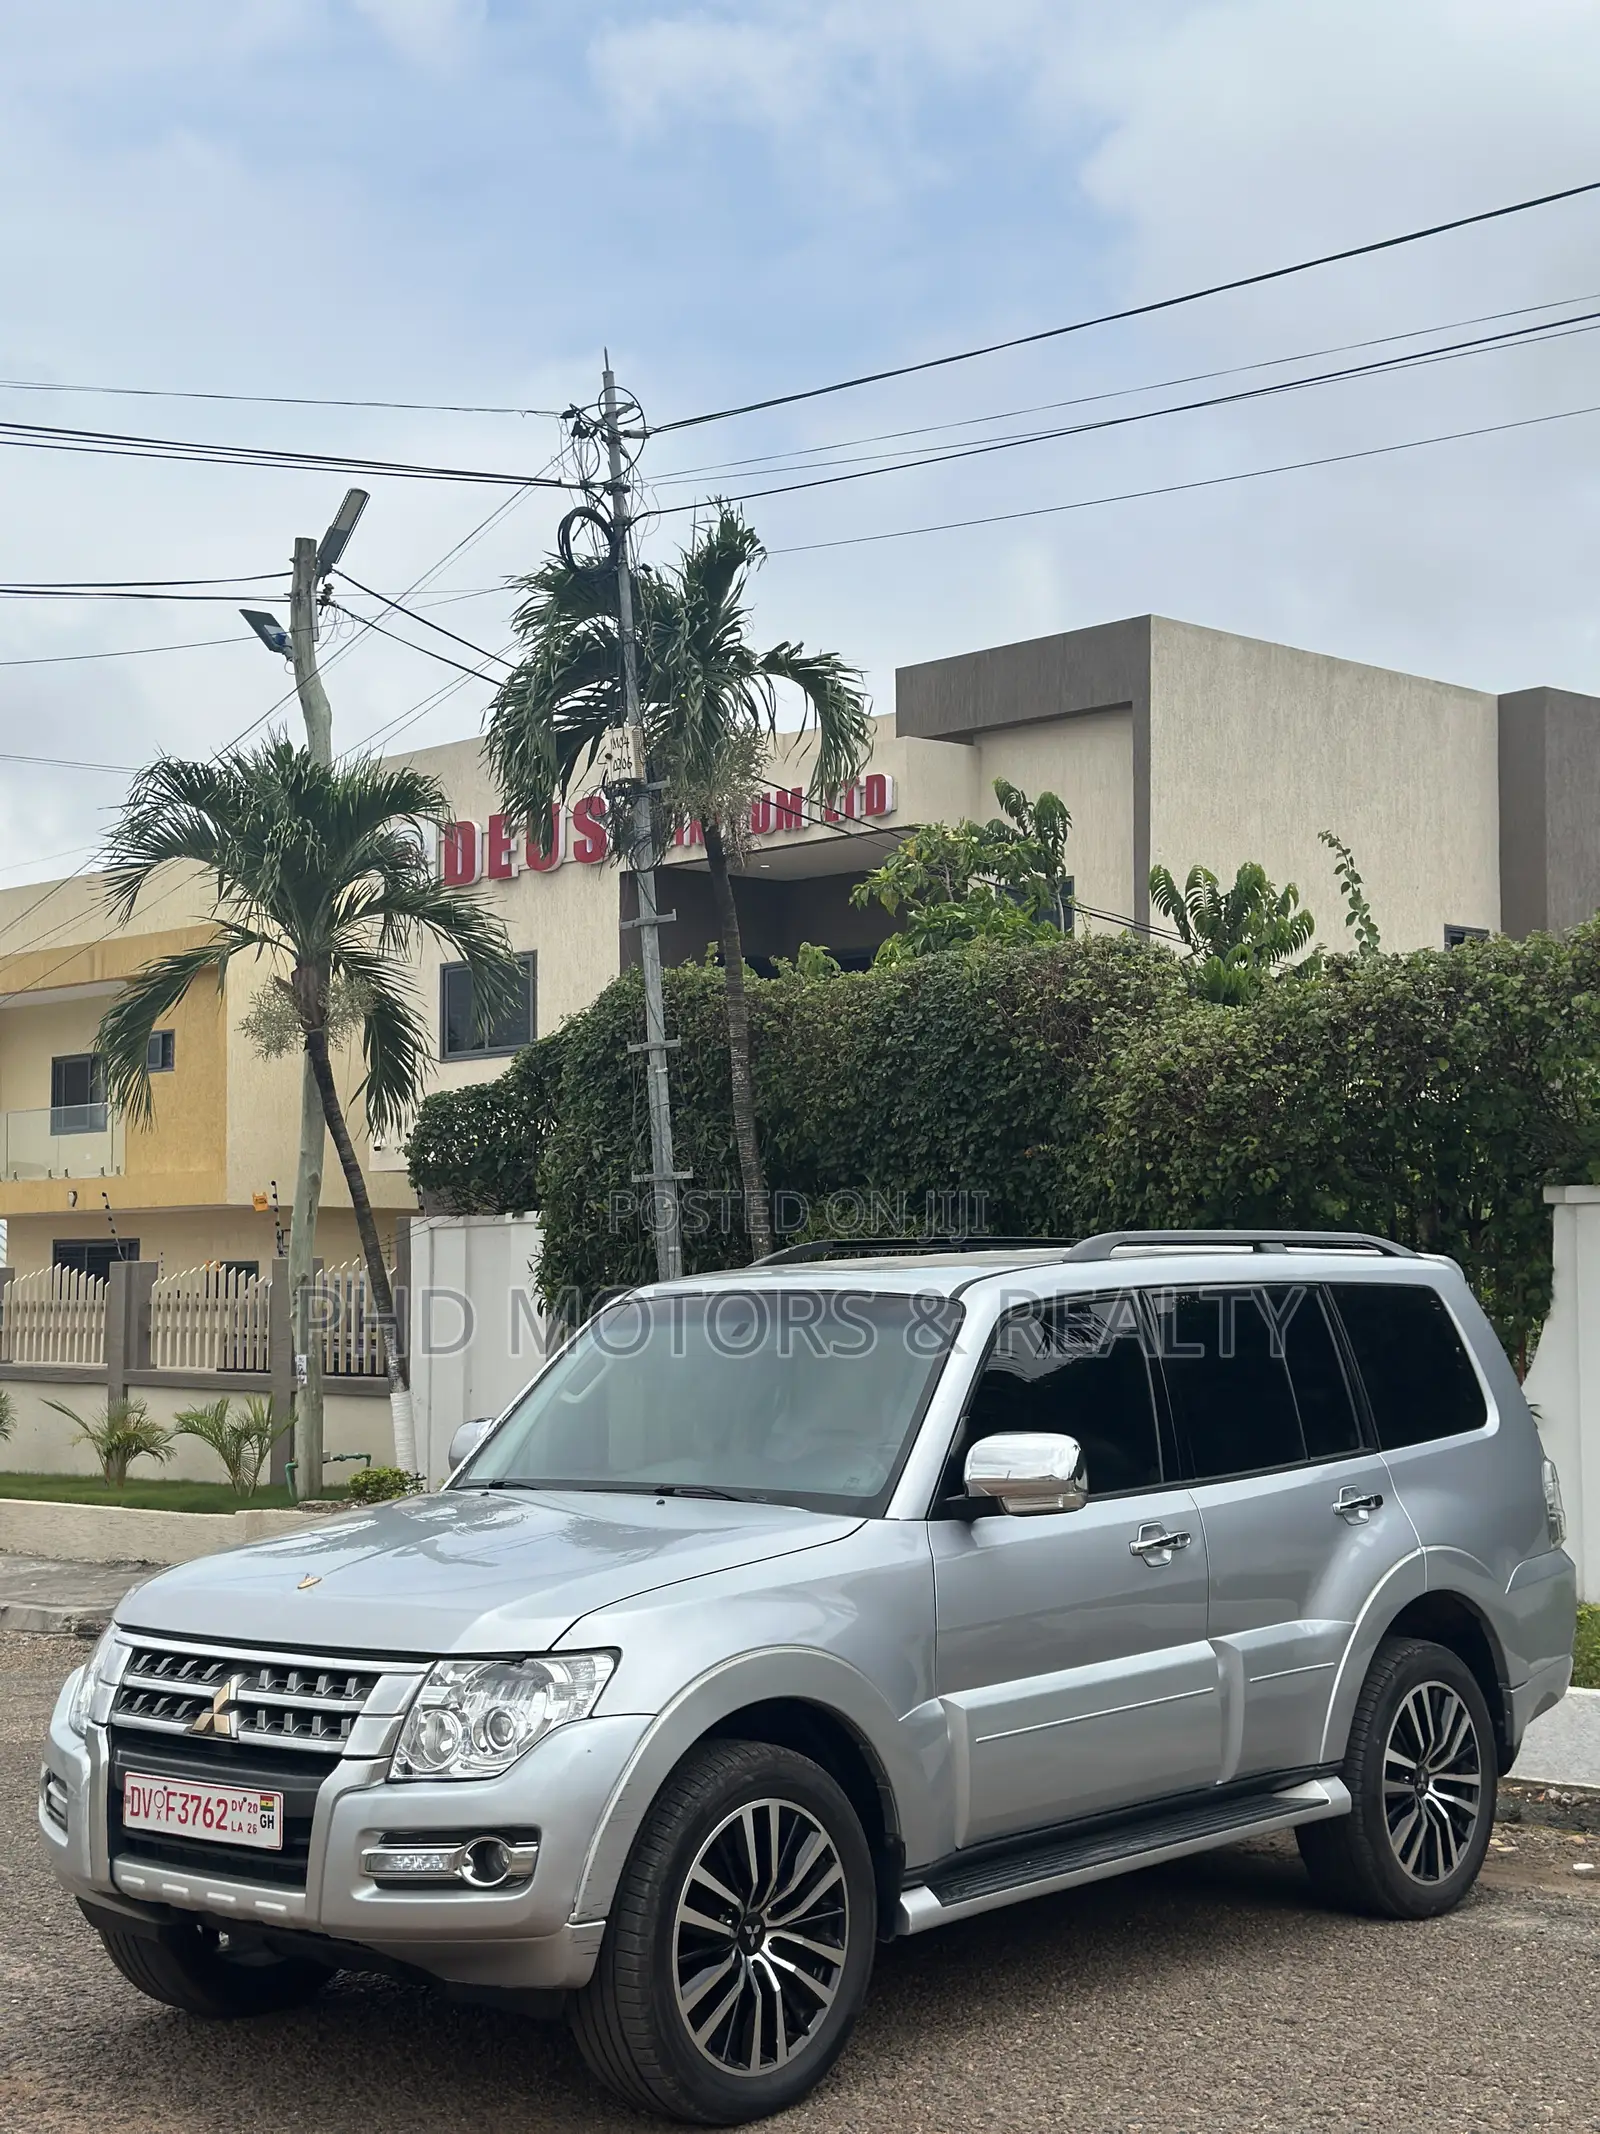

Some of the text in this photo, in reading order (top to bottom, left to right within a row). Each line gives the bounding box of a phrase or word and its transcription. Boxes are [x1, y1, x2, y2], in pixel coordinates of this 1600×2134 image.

[443, 796, 609, 887] DEUS
[129, 1785, 229, 1832] DV F3762
[231, 1800, 258, 1815] DV 20
[231, 1820, 258, 1835] LA 26
[259, 1813, 275, 1830] GH
